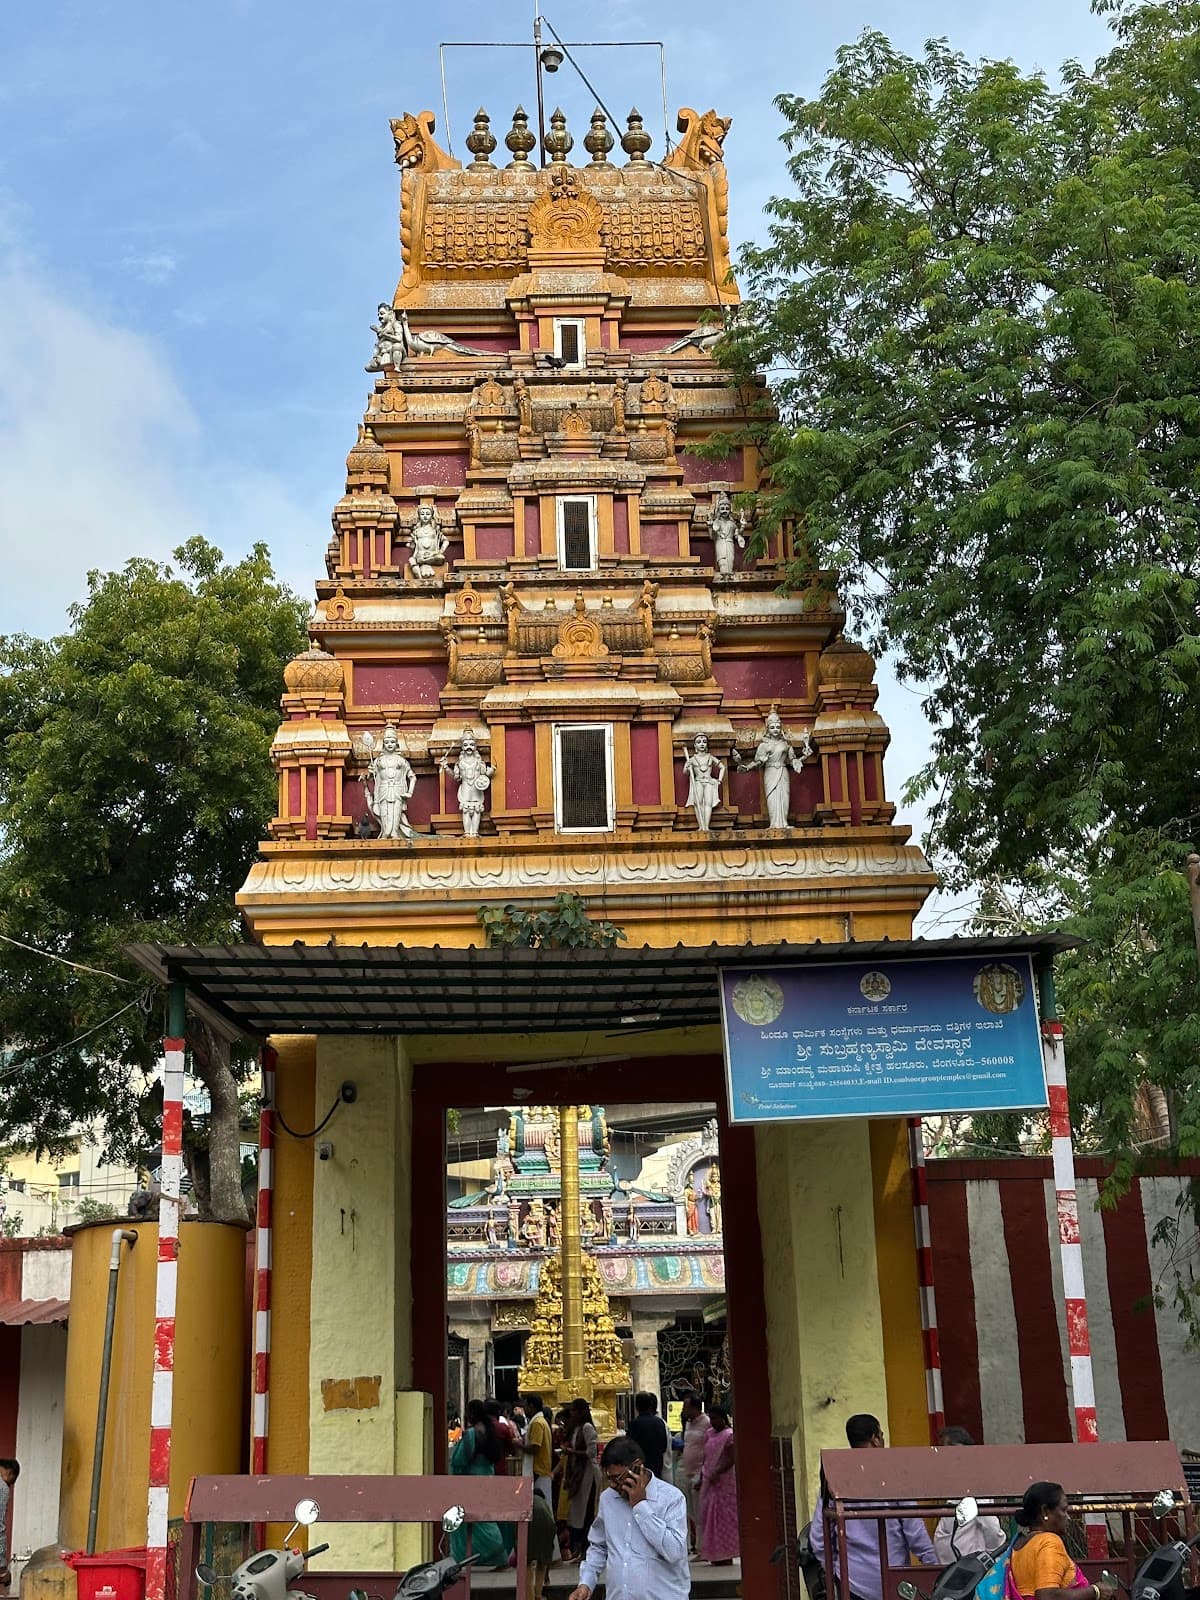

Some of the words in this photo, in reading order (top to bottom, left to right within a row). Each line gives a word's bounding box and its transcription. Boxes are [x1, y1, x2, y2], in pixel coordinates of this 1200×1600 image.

[866, 1026, 888, 1038] ಮತ್ತು
[795, 1044, 813, 1062] ಶ್ರೀ
[819, 1039, 908, 1061] ಸುಬ್ರಹ್ಮಣ್ಯಸ್ವಾಮಿ
[915, 1035, 972, 1056] ದೇವಸ್ಥಾನ
[760, 1066, 772, 1079] ಶ್ರೀ
